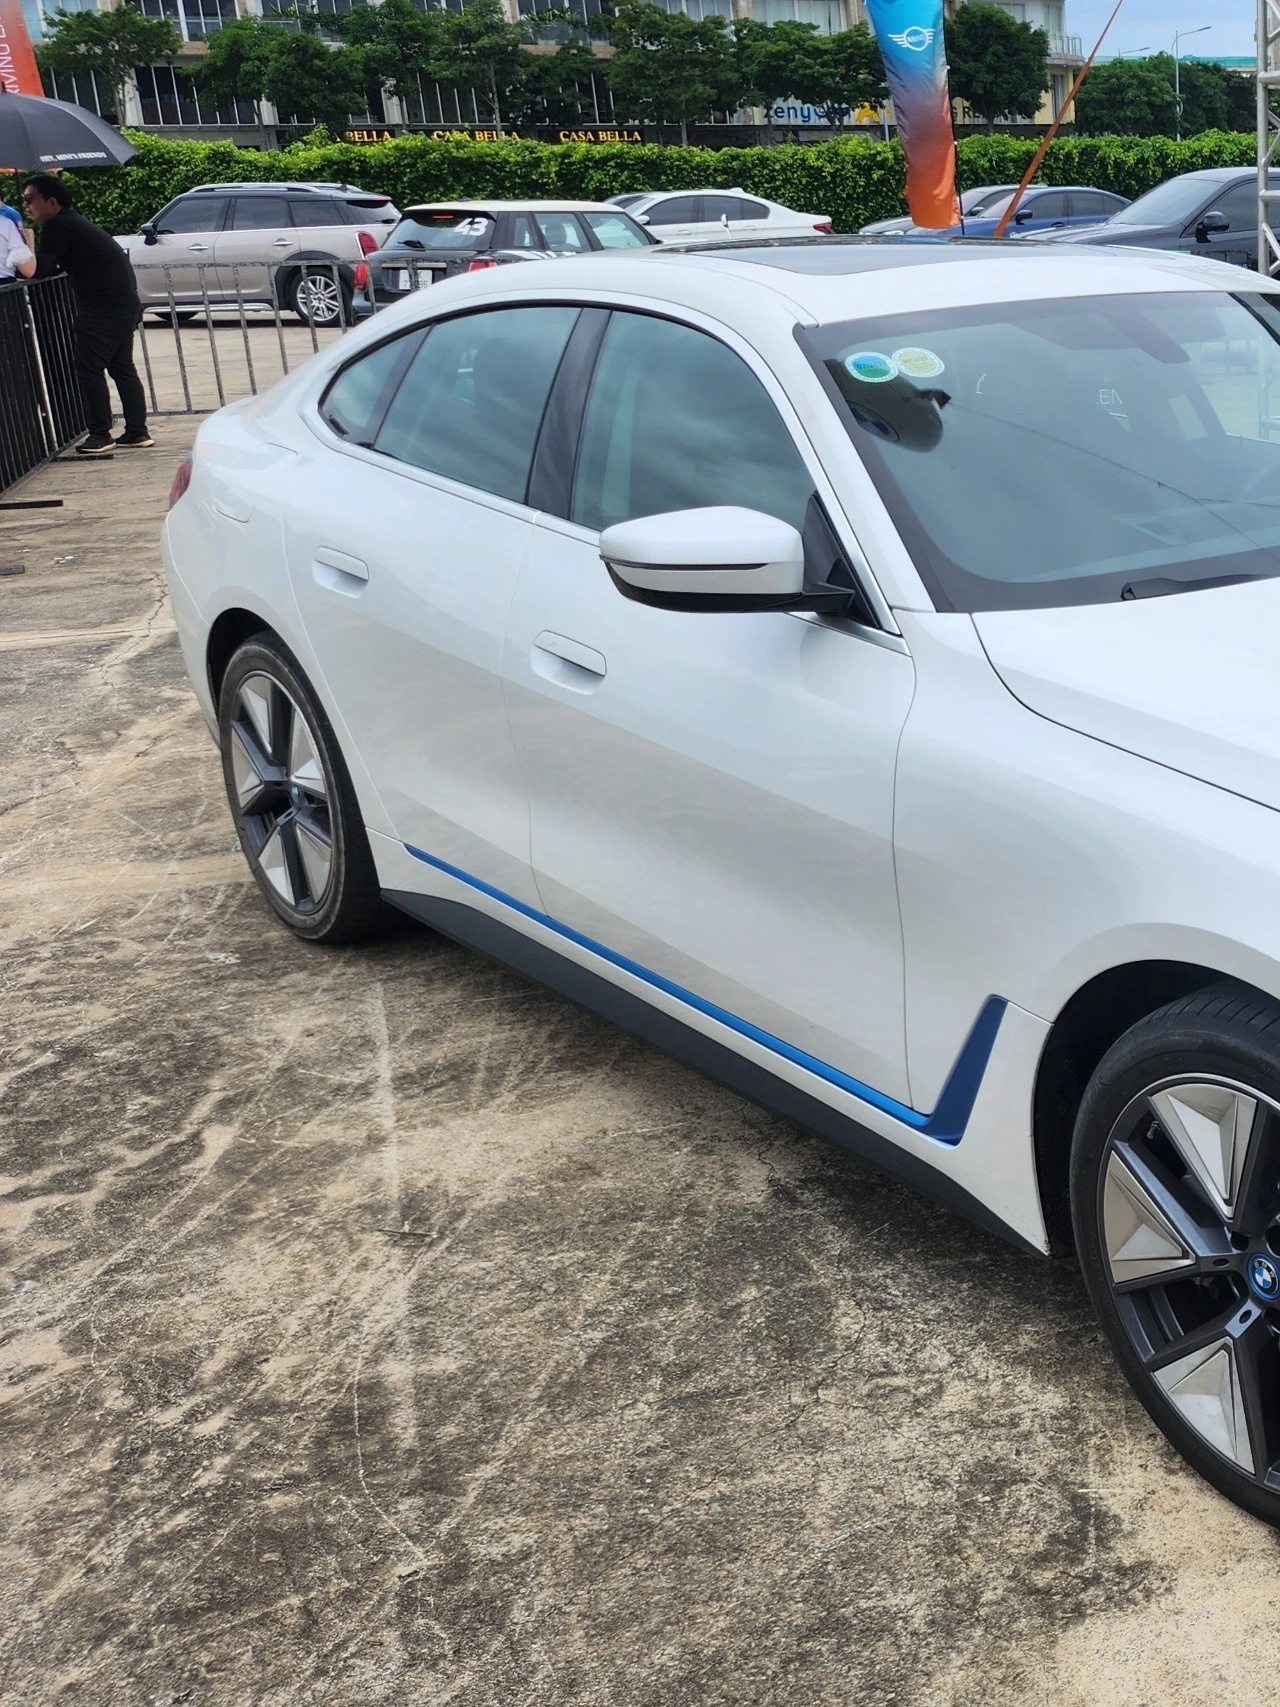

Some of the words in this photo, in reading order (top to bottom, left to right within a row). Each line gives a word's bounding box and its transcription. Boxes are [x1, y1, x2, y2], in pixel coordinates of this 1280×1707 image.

[559, 130, 595, 142] CASA
[598, 130, 642, 142] BELLA
[454, 217, 489, 236] 43
